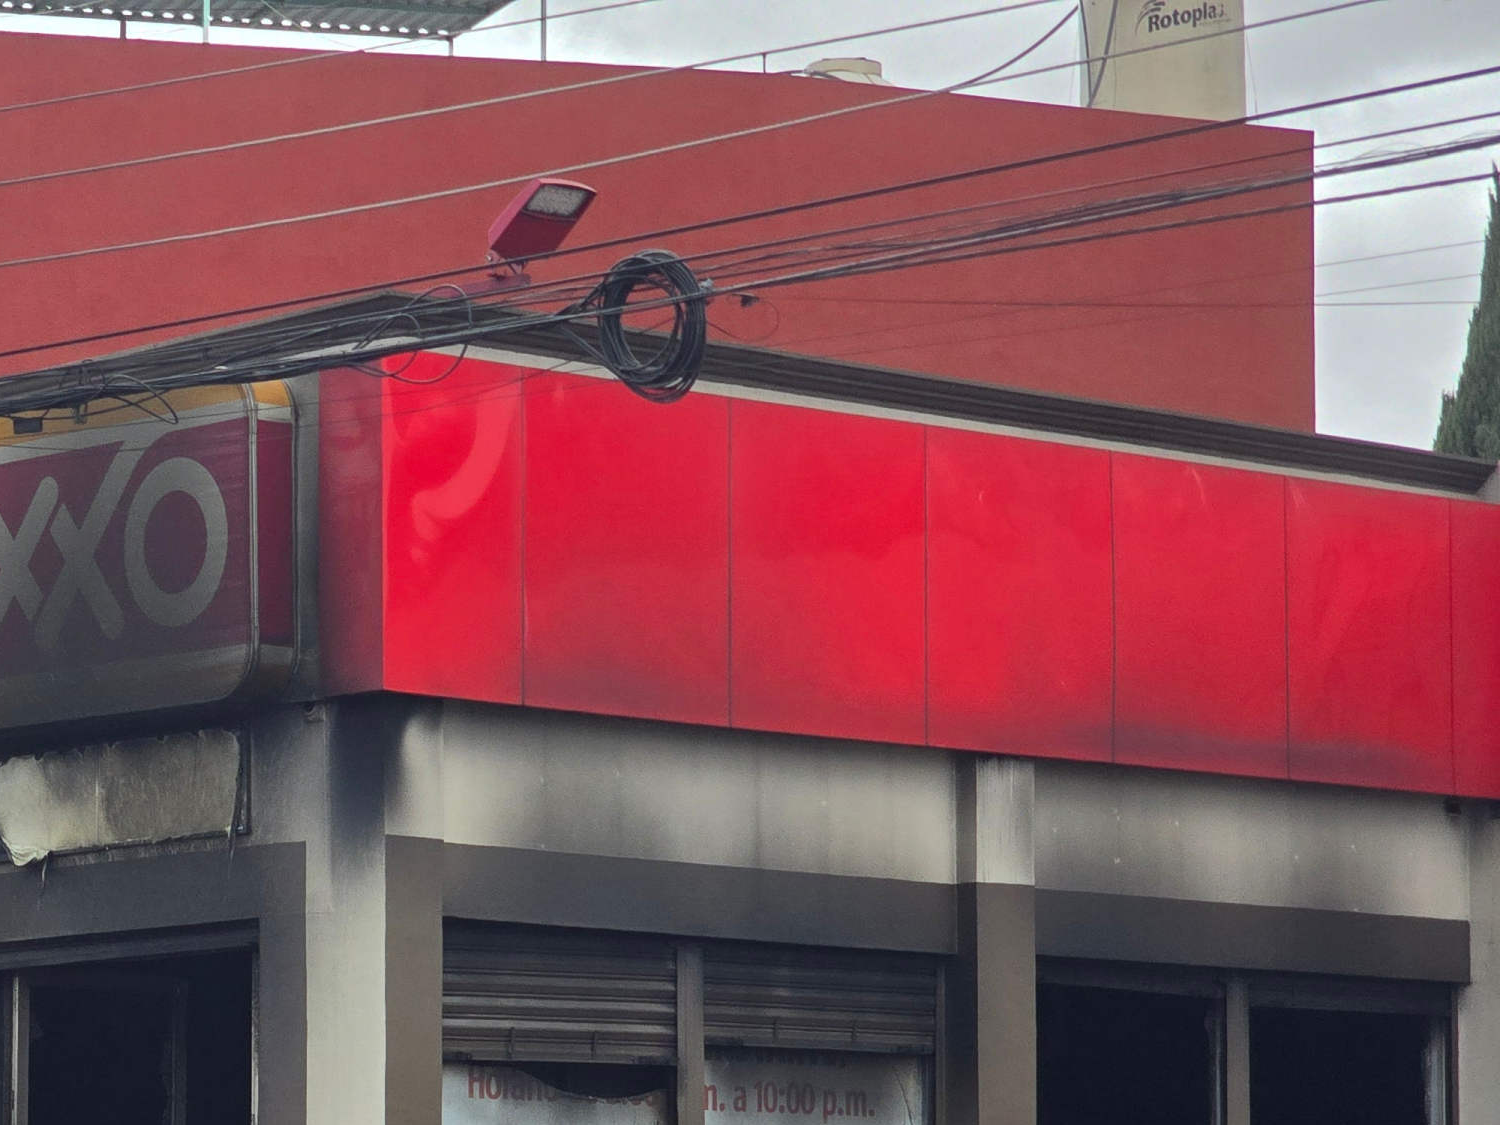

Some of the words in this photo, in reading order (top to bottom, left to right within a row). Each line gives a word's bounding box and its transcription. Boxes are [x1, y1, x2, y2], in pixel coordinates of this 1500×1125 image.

[733, 1086, 747, 1112] a
[754, 1080, 816, 1114] 10:00
[822, 1088, 876, 1124] p.m.
